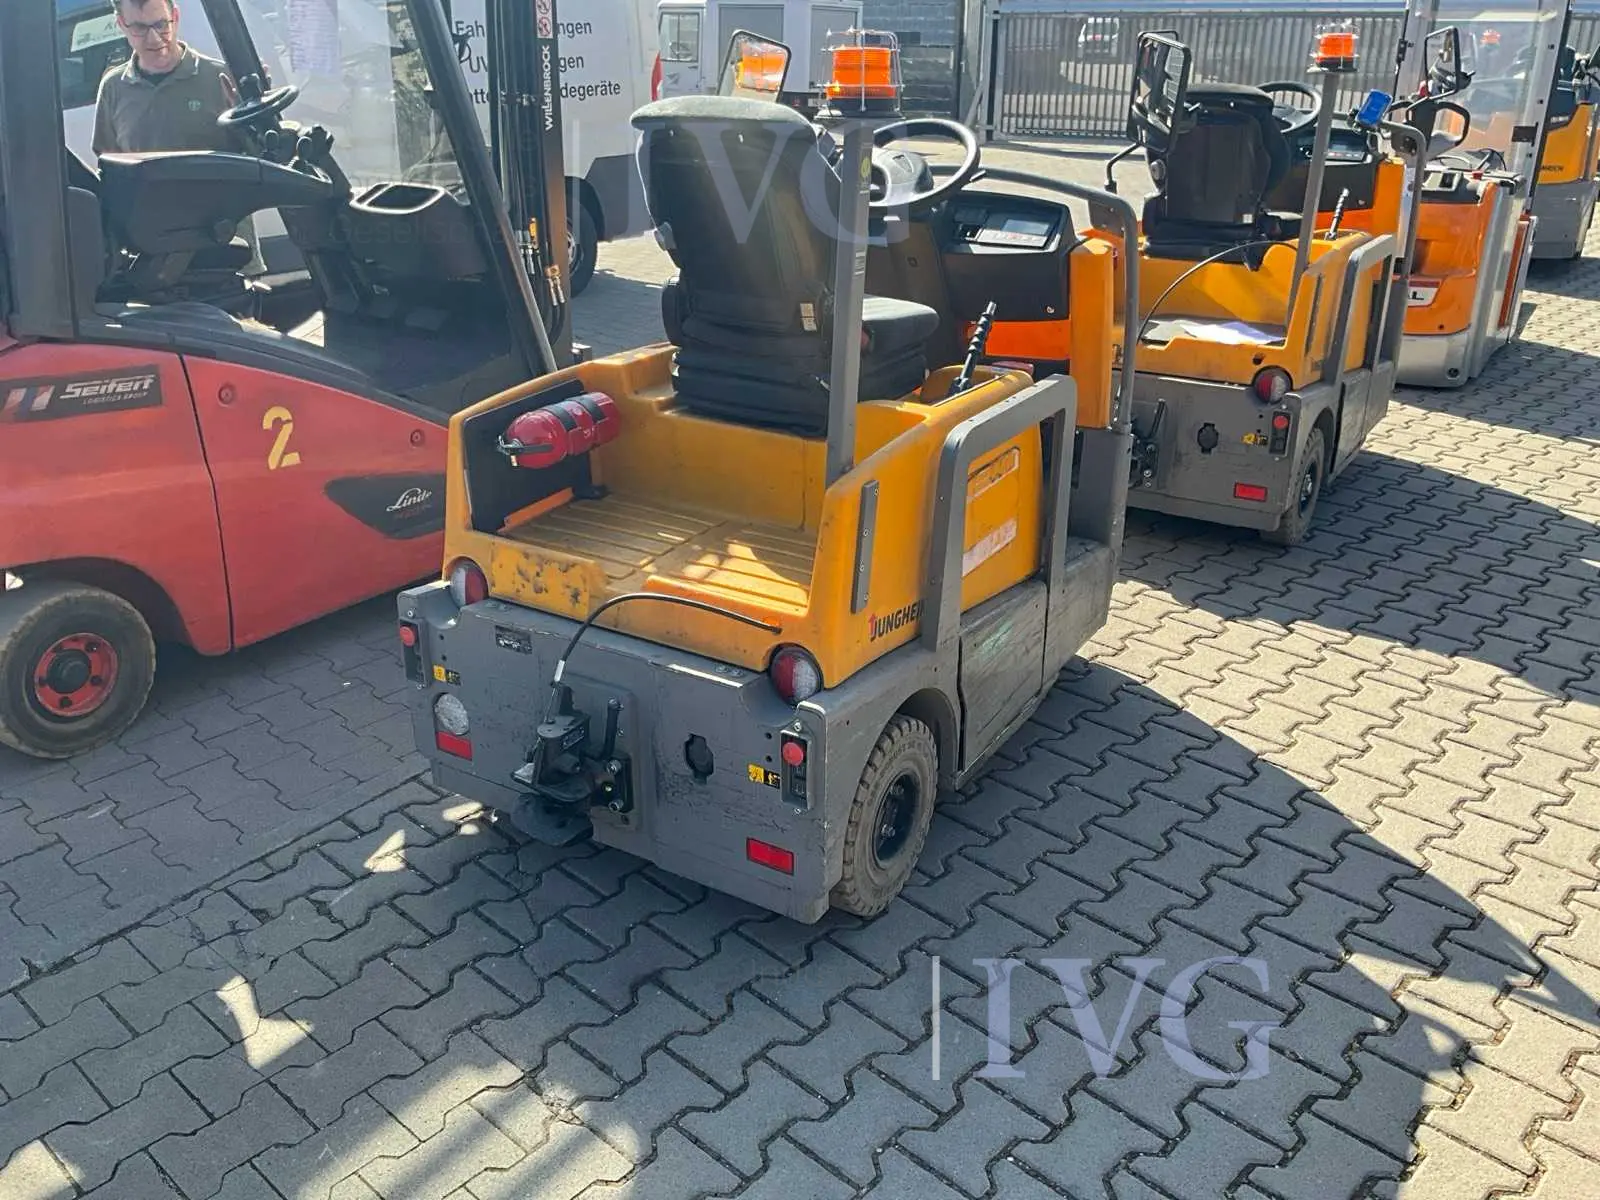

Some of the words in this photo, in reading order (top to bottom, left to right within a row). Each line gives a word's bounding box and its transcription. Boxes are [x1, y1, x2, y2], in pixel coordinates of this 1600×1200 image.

[455, 20, 485, 37] Fah
[558, 21, 592, 38] ngen
[559, 55, 584, 73] gen
[541, 45, 553, 131] WILLENBROCK
[560, 80, 621, 101] degeräte
[60, 374, 155, 399] Seifert
[263, 406, 301, 471] 2
[386, 487, 432, 511] Linde
